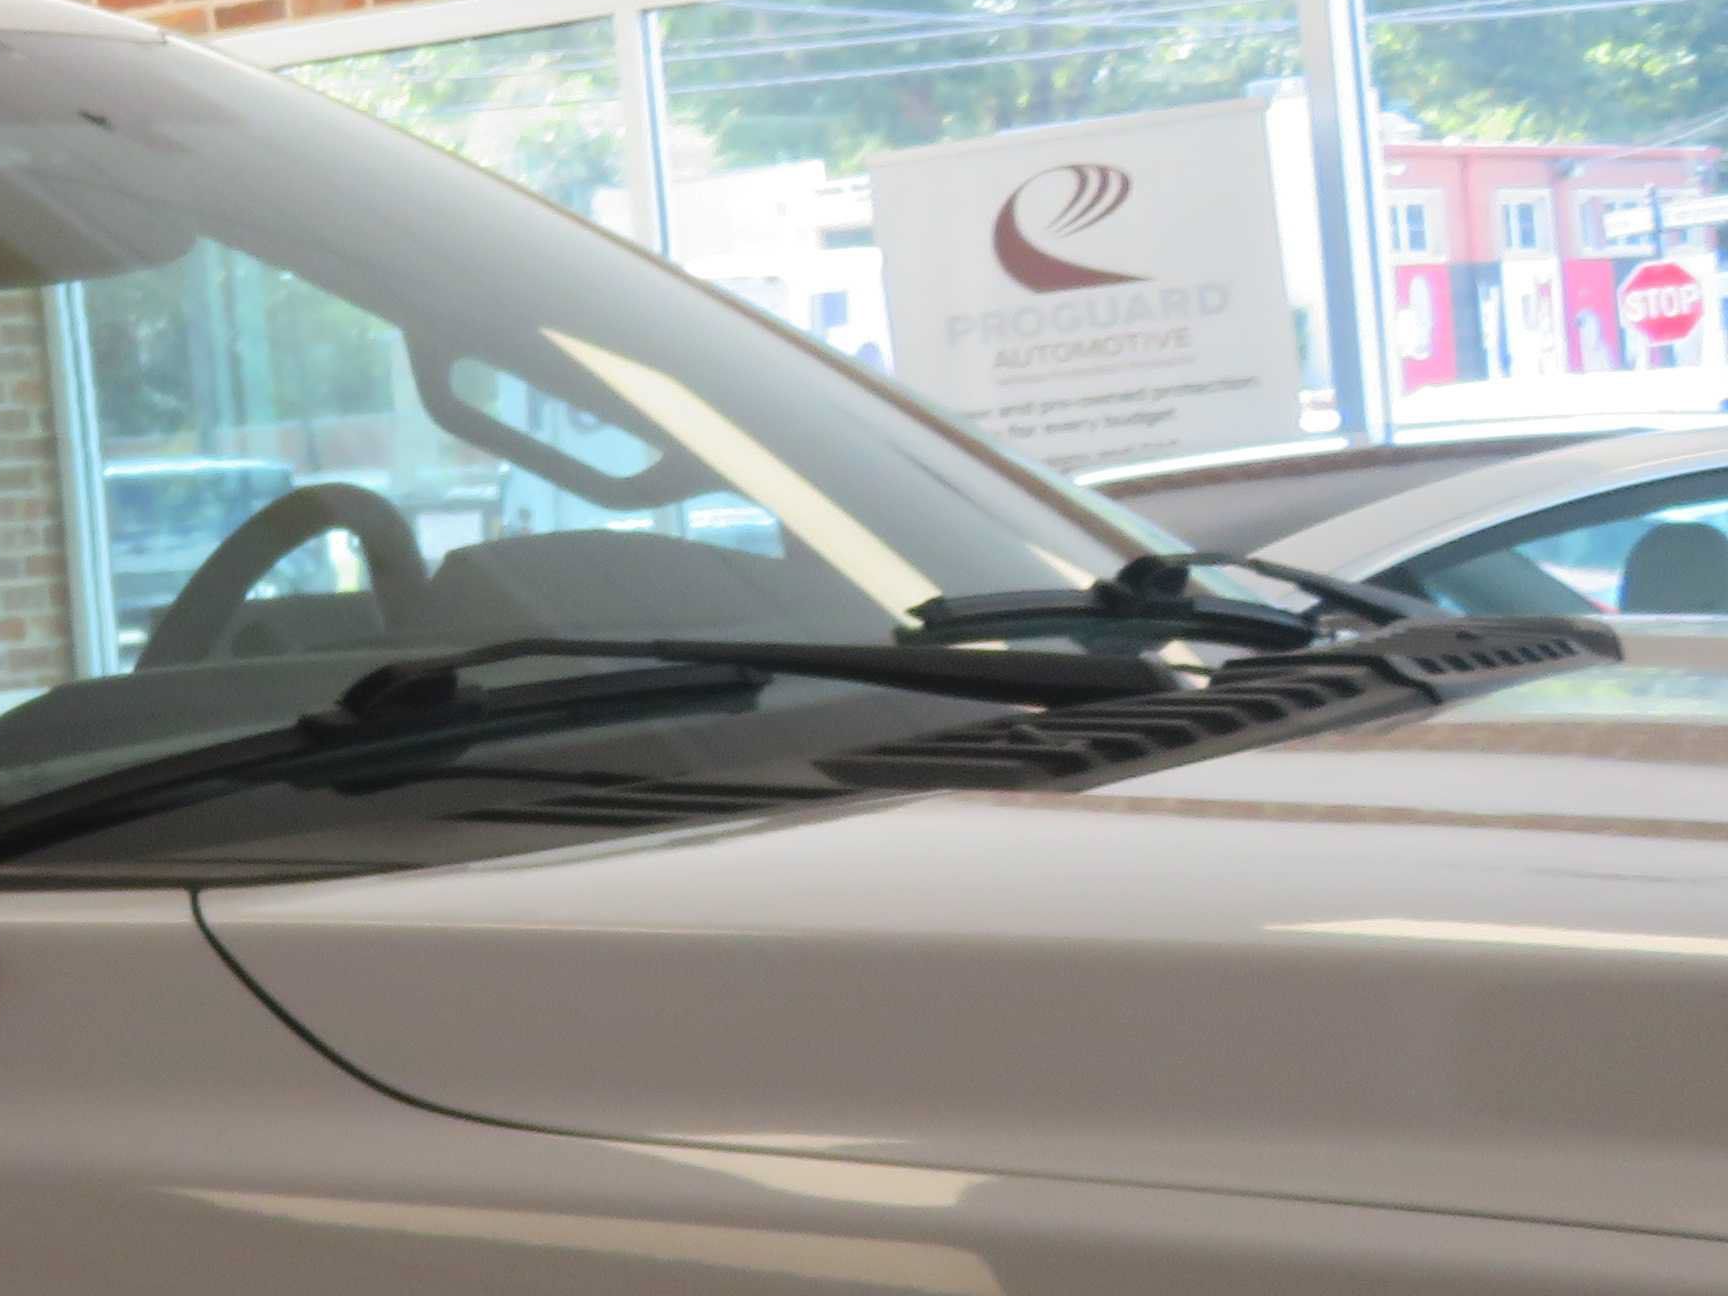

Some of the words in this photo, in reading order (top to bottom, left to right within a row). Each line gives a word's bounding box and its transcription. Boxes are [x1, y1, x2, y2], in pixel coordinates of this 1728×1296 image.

[944, 281, 1232, 348] PROGUARD
[1624, 282, 1702, 324] STOP
[993, 326, 1193, 368] AUTOMOTIVE
